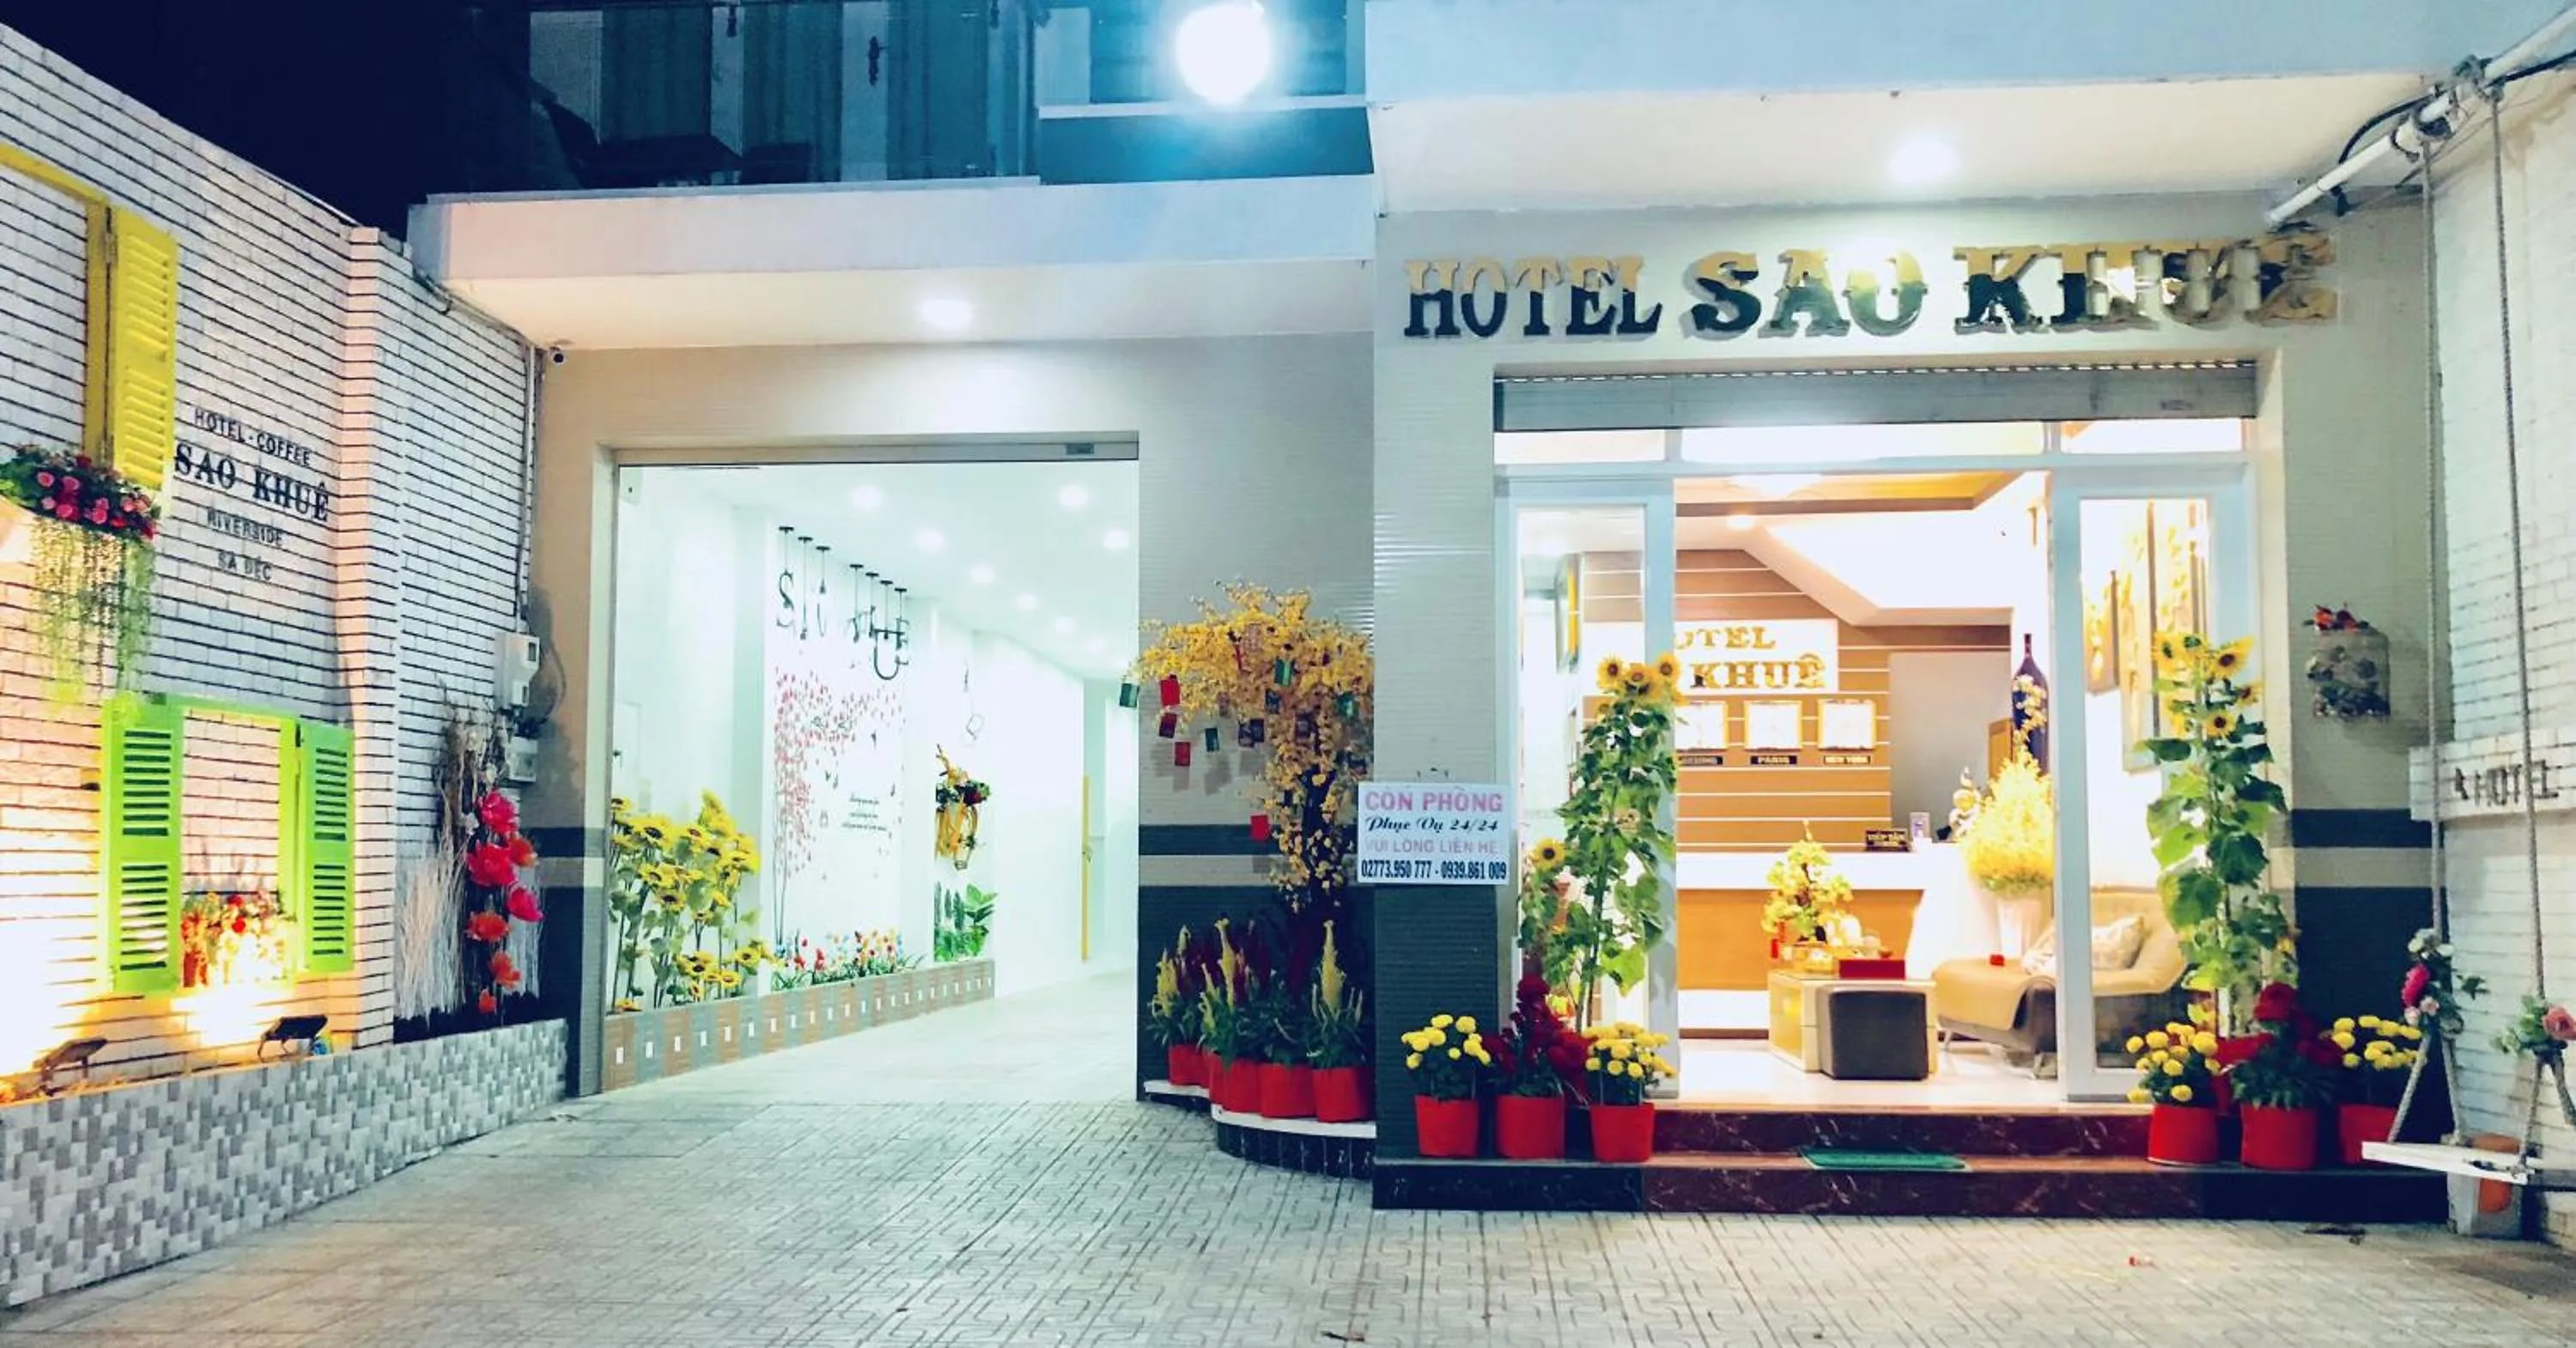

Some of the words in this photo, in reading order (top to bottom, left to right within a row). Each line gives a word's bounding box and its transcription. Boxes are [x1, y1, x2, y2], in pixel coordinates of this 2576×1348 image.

[1403, 255, 1664, 339] HOTEL
[1678, 247, 1929, 340] SAO
[194, 408, 247, 444] HOTEL
[256, 429, 313, 467] COFFEE
[175, 443, 236, 489] SAO
[253, 467, 329, 521] KHUÊ
[207, 507, 283, 548] RIVERSIDE
[217, 550, 237, 569] SA
[1449, 818, 1498, 834] 24/24
[1414, 859, 1432, 878] 777
